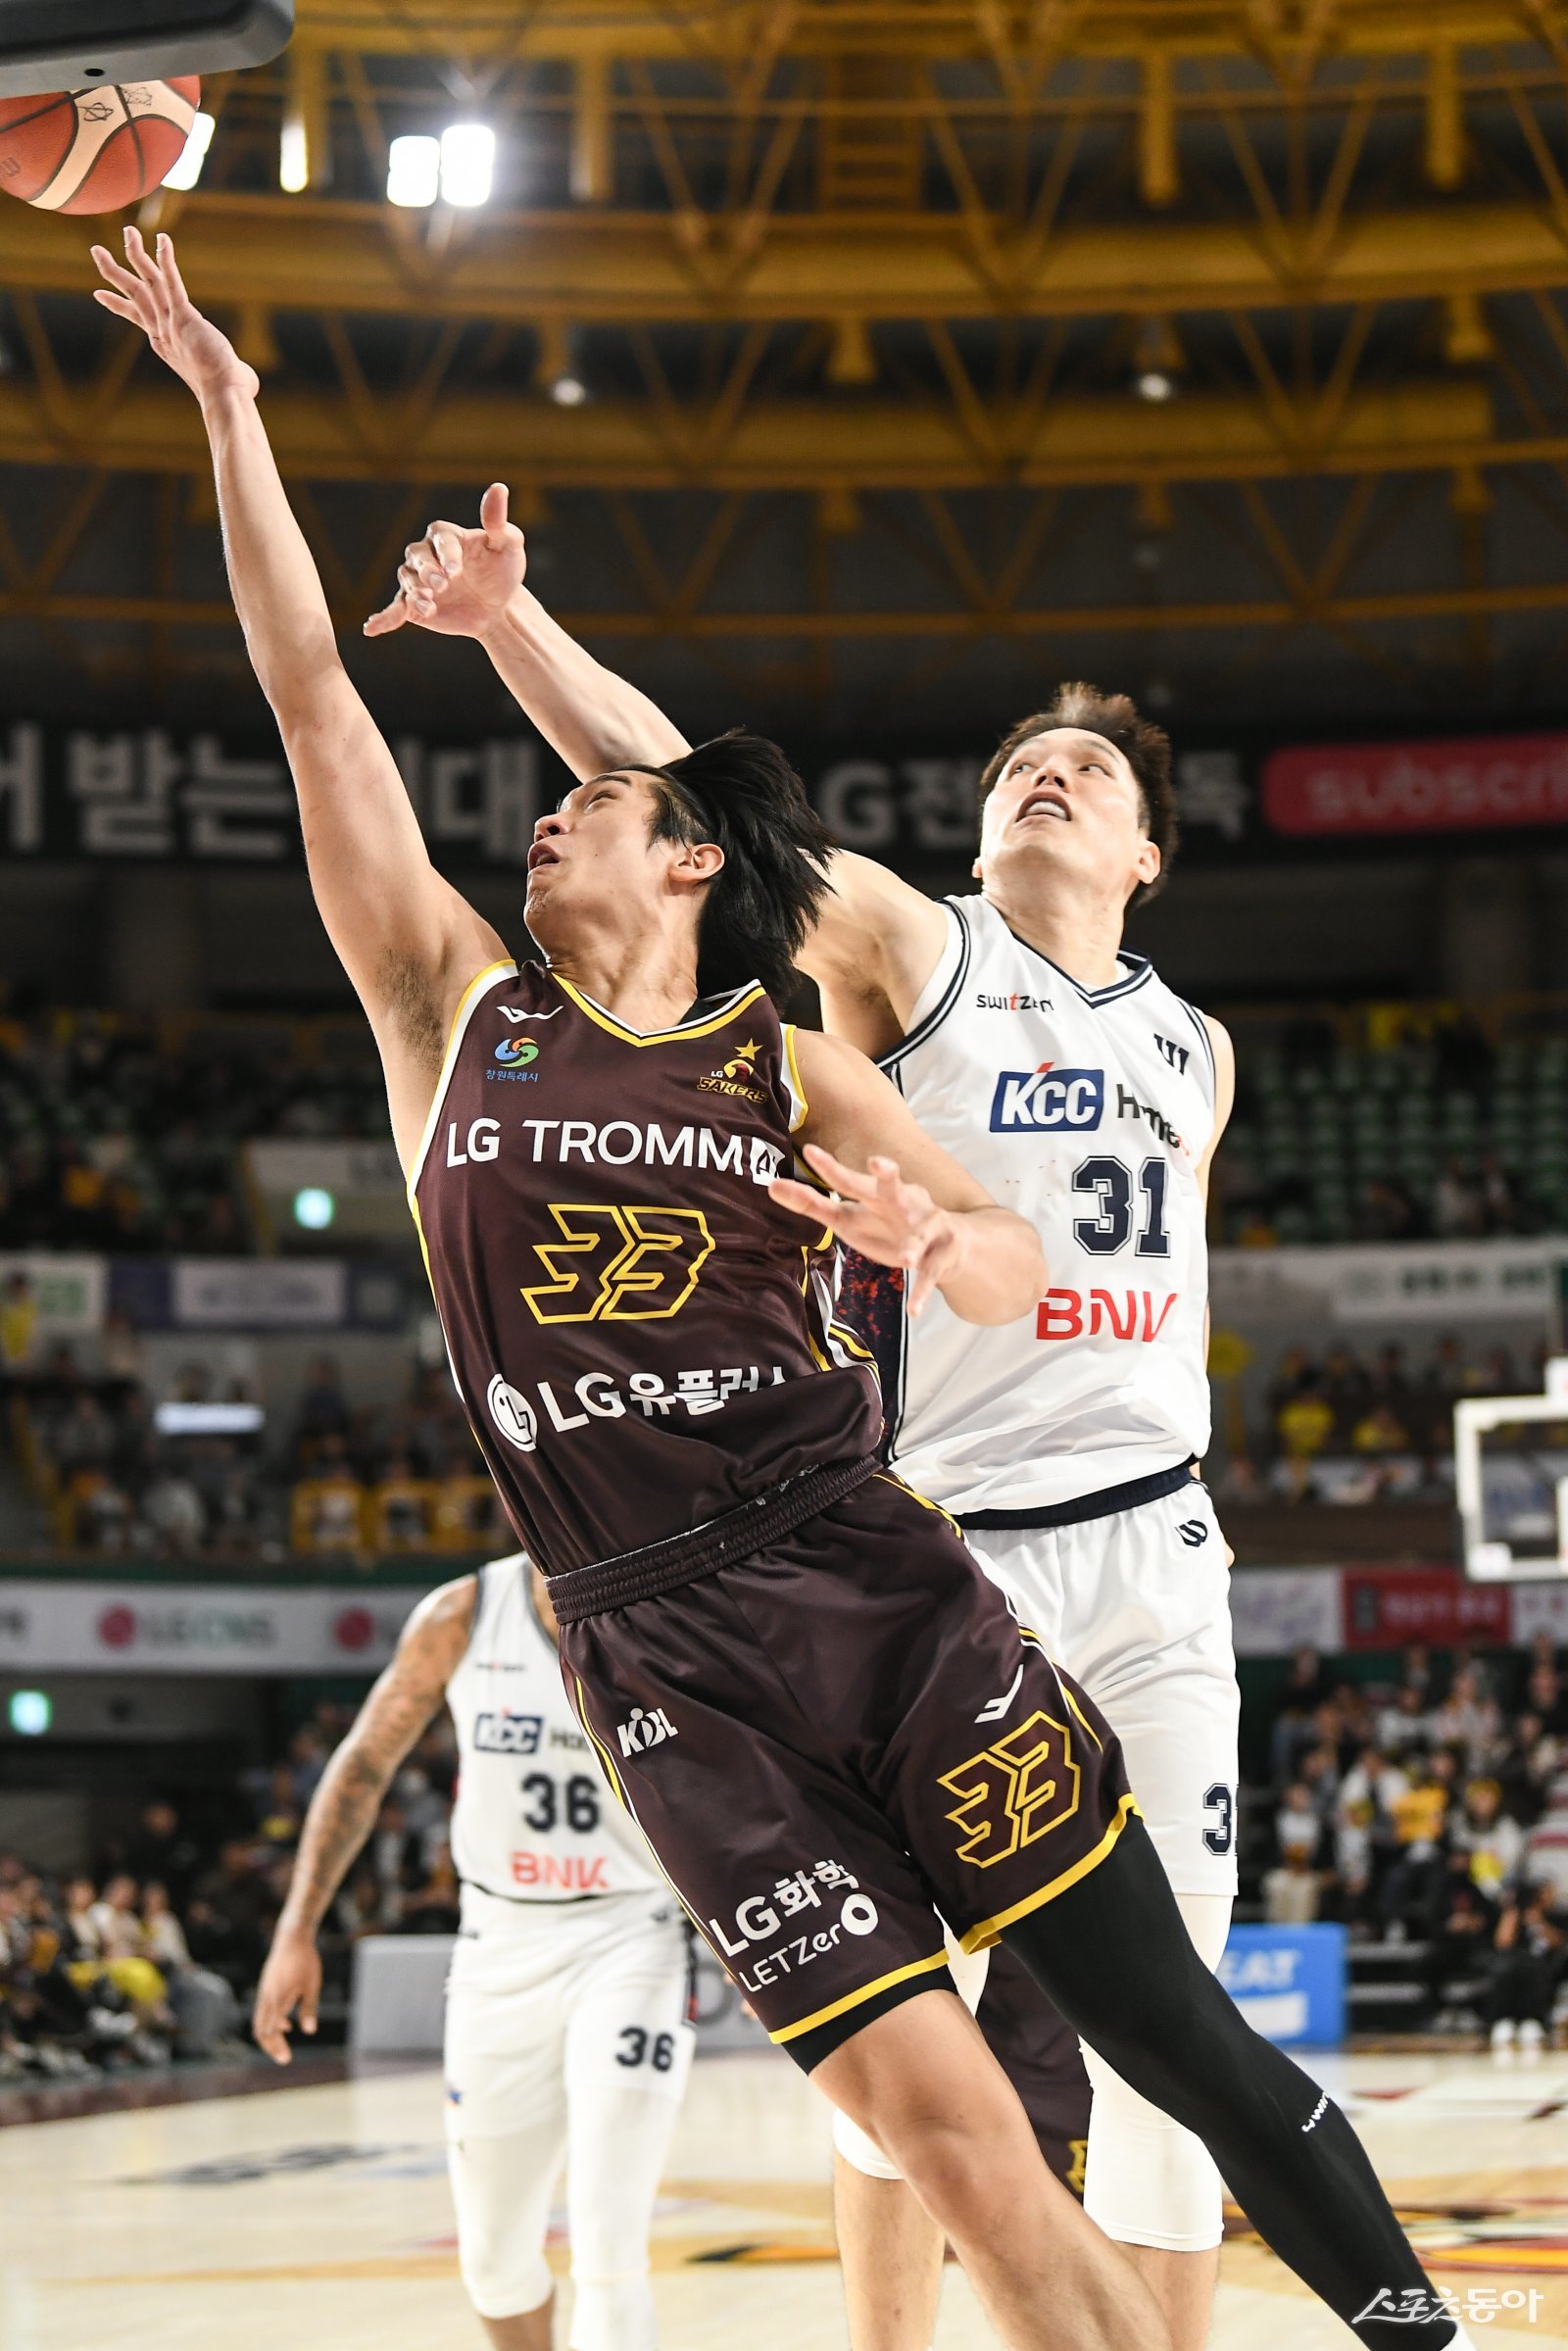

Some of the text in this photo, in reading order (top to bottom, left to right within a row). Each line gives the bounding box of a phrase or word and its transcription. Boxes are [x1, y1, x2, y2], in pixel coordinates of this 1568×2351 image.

[65, 725, 295, 858] 받는
[486, 1069, 539, 1083] 창원특례시
[697, 1077, 767, 1103] SAKERS
[1000, 1062, 1180, 1149] KCC Hme
[446, 1117, 501, 1168] LG
[521, 1119, 744, 1176] TROMM
[1072, 1154, 1172, 1258] 31
[519, 1203, 716, 1325] 33
[537, 1365, 787, 1433] LG유플러
[476, 1709, 541, 1752] KCC
[616, 1707, 678, 1758] KBL
[522, 1773, 601, 1834] 36
[936, 1709, 1080, 1868] 33
[1202, 1783, 1238, 1856] 3
[511, 1851, 610, 1889] BNK
[709, 1858, 859, 1958] LG화학
[615, 2026, 675, 2073] 36
